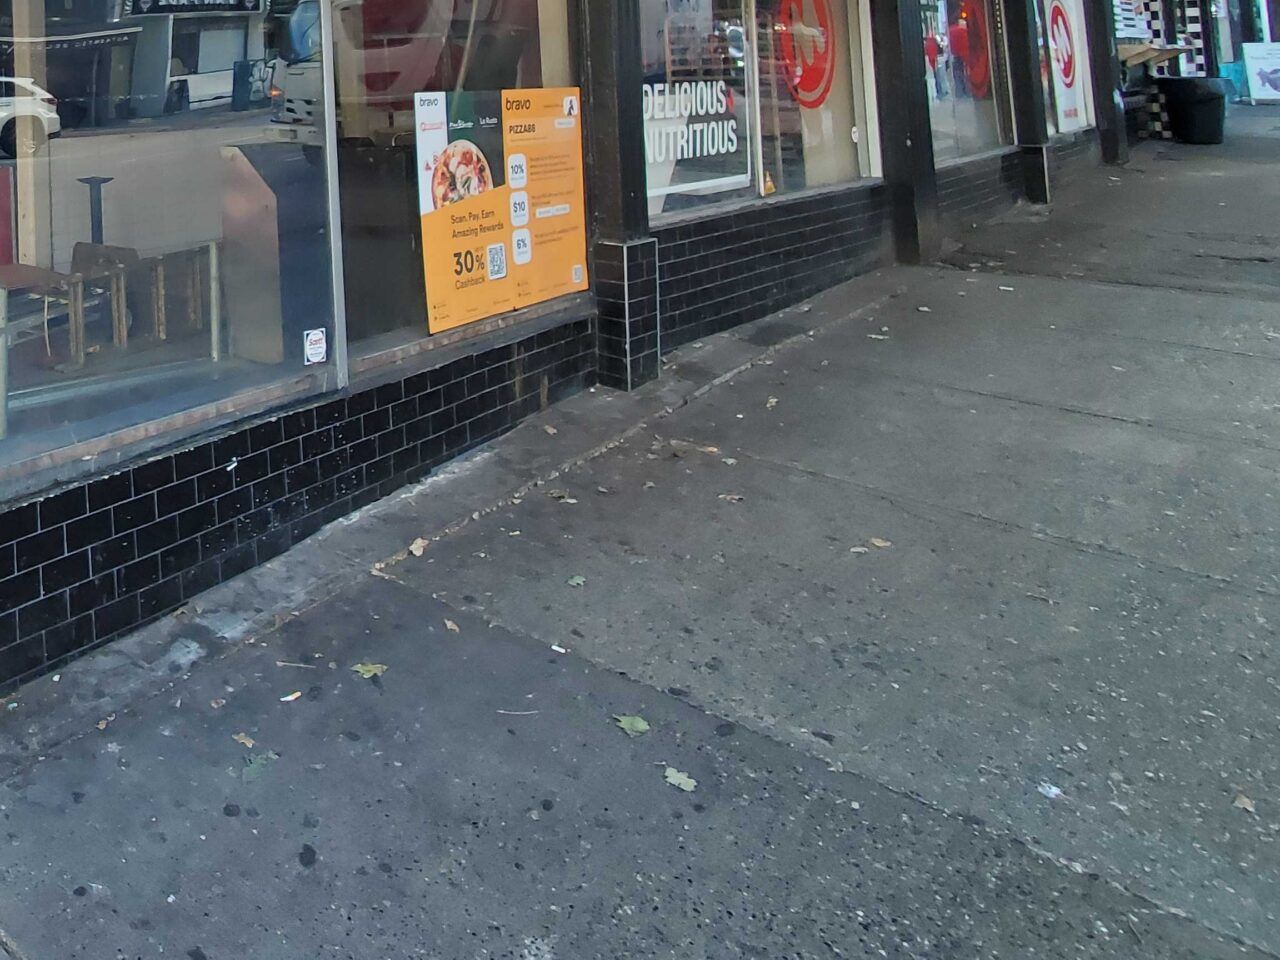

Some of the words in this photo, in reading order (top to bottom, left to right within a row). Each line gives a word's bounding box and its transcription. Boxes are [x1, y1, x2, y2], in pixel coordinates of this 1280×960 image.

[505, 98, 531, 111] bravo
[642, 80, 726, 120] DELICIOUS
[644, 119, 738, 164] NUTRITIOUS
[511, 162, 524, 175] 10%
[513, 201, 526, 213] $10
[481, 209, 495, 219] Earn
[452, 226, 479, 238] Amazing
[479, 221, 504, 233] Rewards
[455, 276, 485, 290] Cashback
